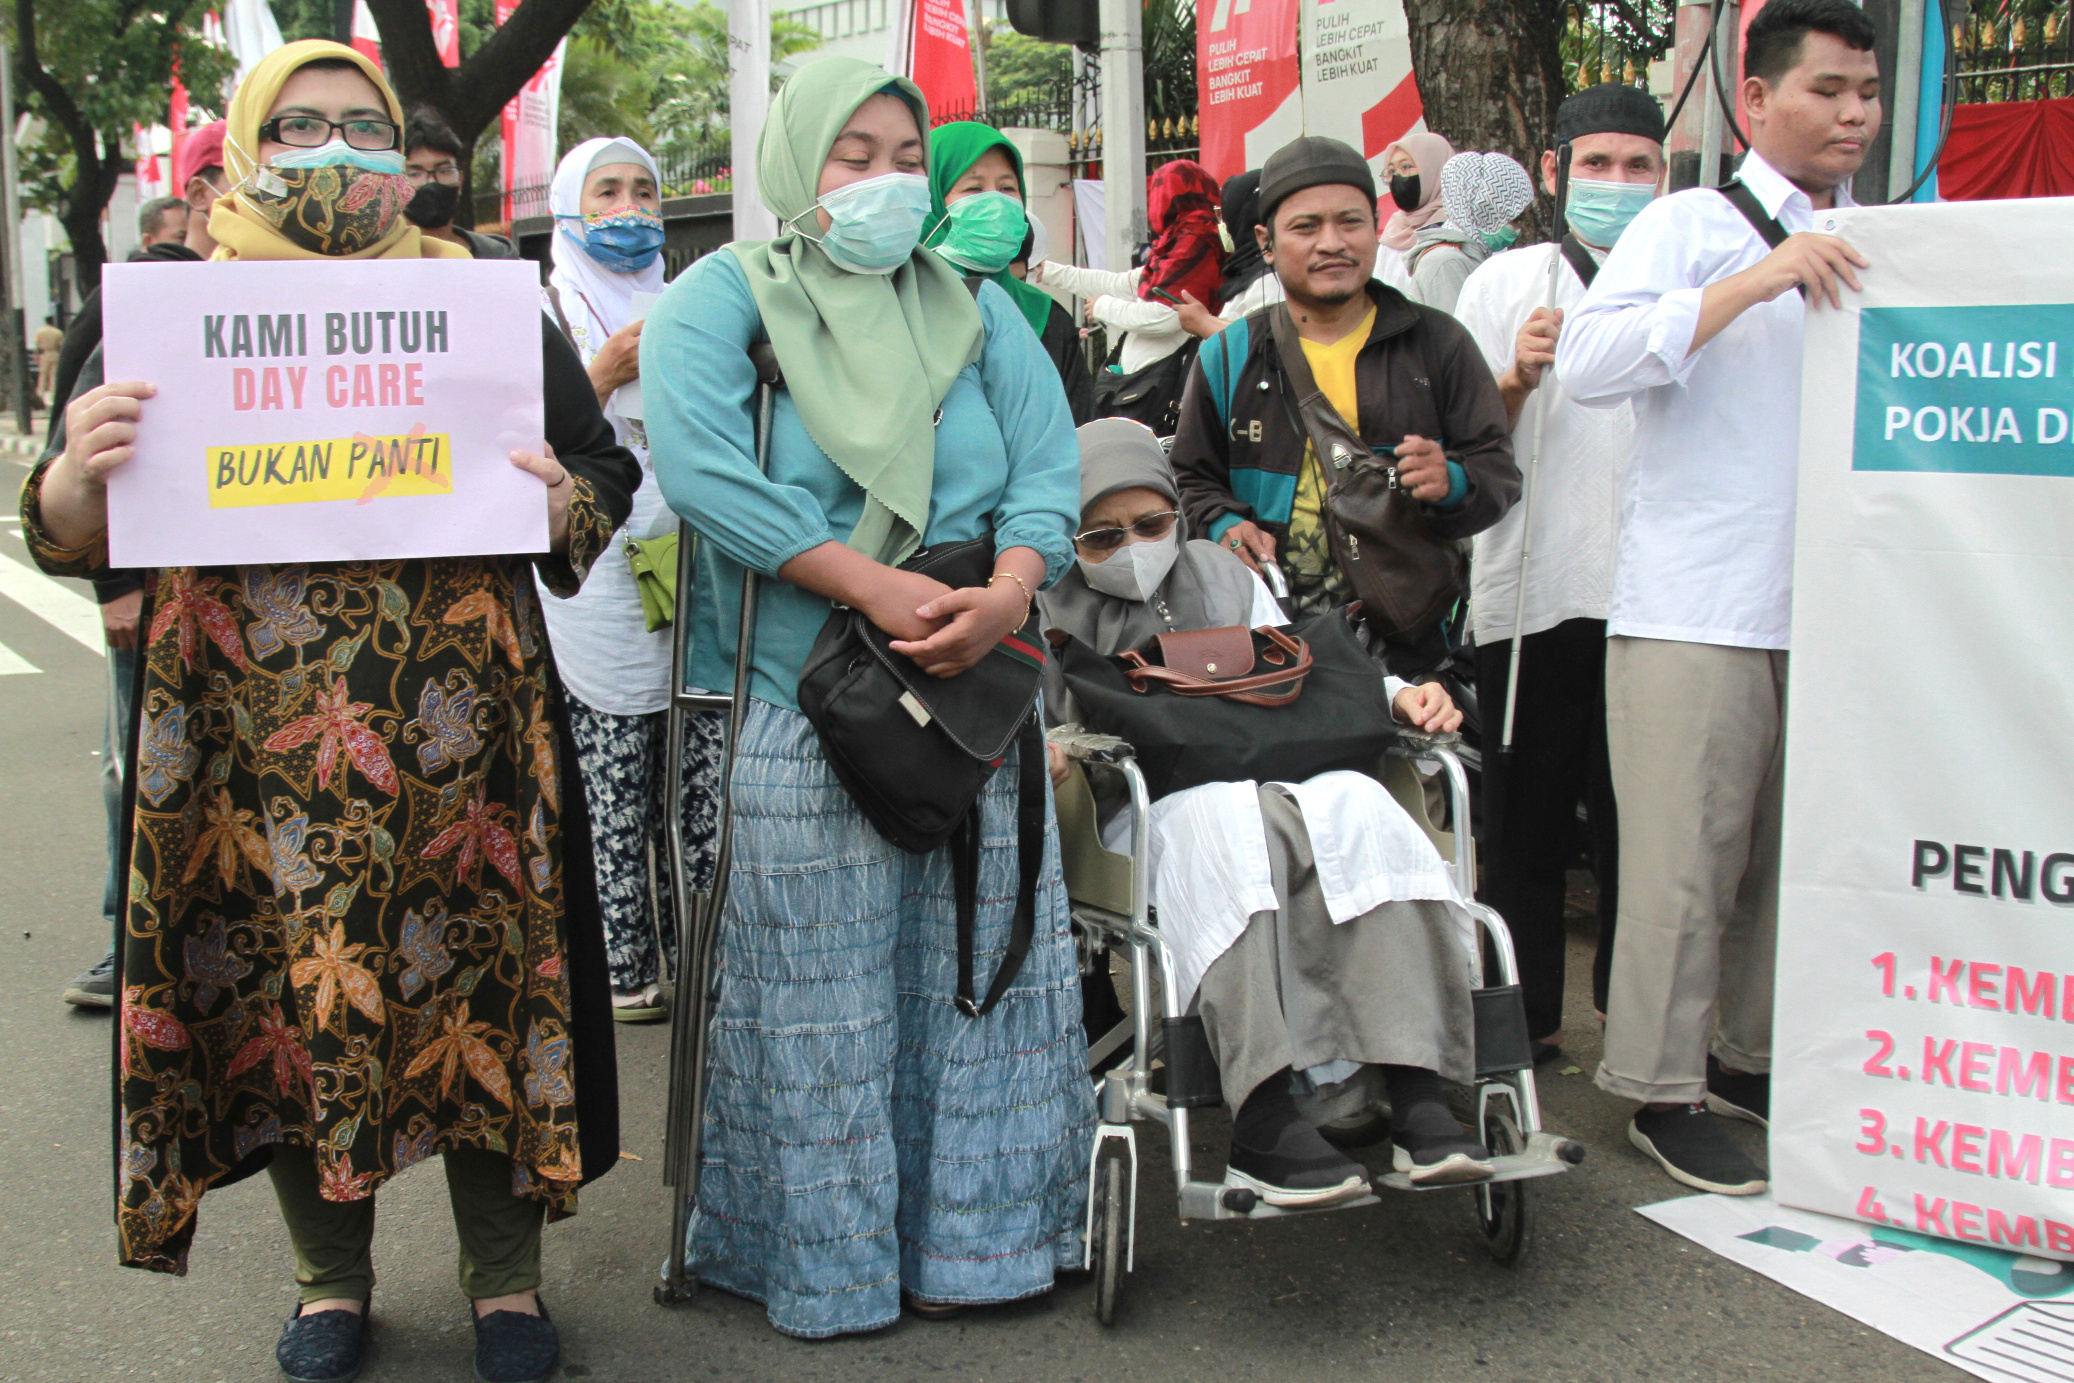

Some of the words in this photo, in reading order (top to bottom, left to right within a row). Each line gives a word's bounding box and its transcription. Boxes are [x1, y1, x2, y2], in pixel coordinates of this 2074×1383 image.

[1316, 12, 1350, 31] PULIH
[1316, 29, 1347, 49] LEBIH
[1348, 21, 1385, 42] CEPAT
[1208, 57, 1234, 73] LEBIH
[1235, 47, 1268, 66] CEPAT
[1209, 39, 1237, 57] PULIH
[1316, 44, 1364, 67] BANGKIT
[1209, 69, 1251, 90] BANGKIT
[1317, 65, 1349, 82] LEBIH
[1350, 57, 1379, 76] KUAT
[1209, 88, 1235, 105] LEBIH
[1236, 82, 1264, 99] KUAT
[203, 313, 308, 358] KAMI
[324, 310, 449, 356] BUTUH
[1890, 341, 2057, 378] KOALISI
[232, 365, 308, 411] DAY
[325, 362, 425, 409] CARE
[1884, 405, 2023, 444] POKJA
[2037, 407, 2074, 445] D
[216, 442, 333, 490] BUKAN
[347, 437, 440, 480] PANTI
[1911, 839, 2074, 906] PENG
